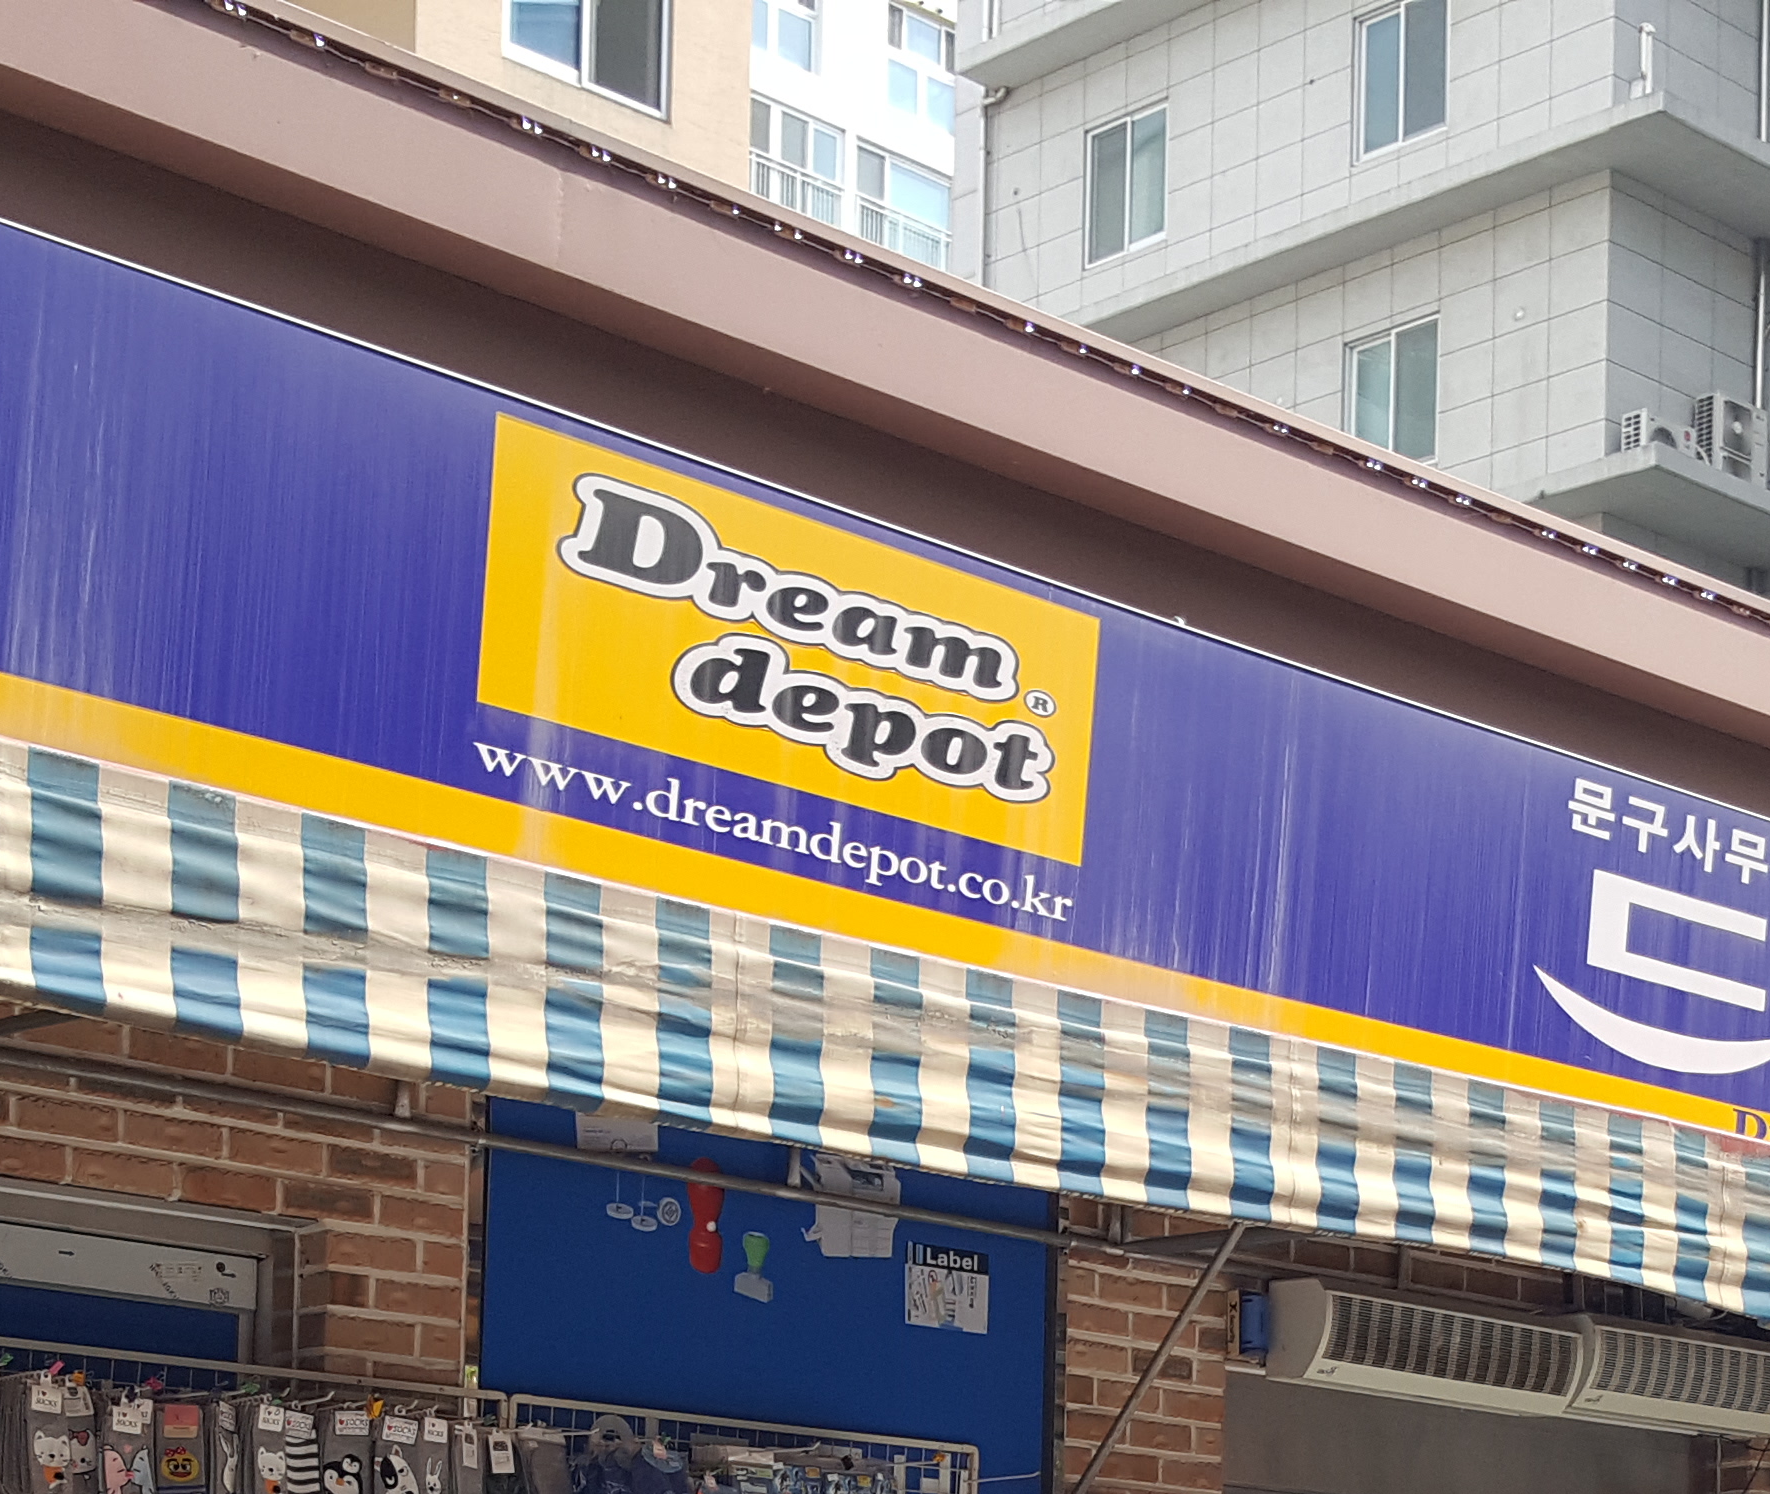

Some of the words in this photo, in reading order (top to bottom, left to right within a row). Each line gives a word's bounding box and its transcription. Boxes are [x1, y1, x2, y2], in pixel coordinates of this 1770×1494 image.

[561, 475, 1018, 699] Dream
[673, 634, 1054, 801] depot
[472, 740, 1074, 923] www.dreamdepot.co.kr
[926, 1246, 979, 1272] Label
